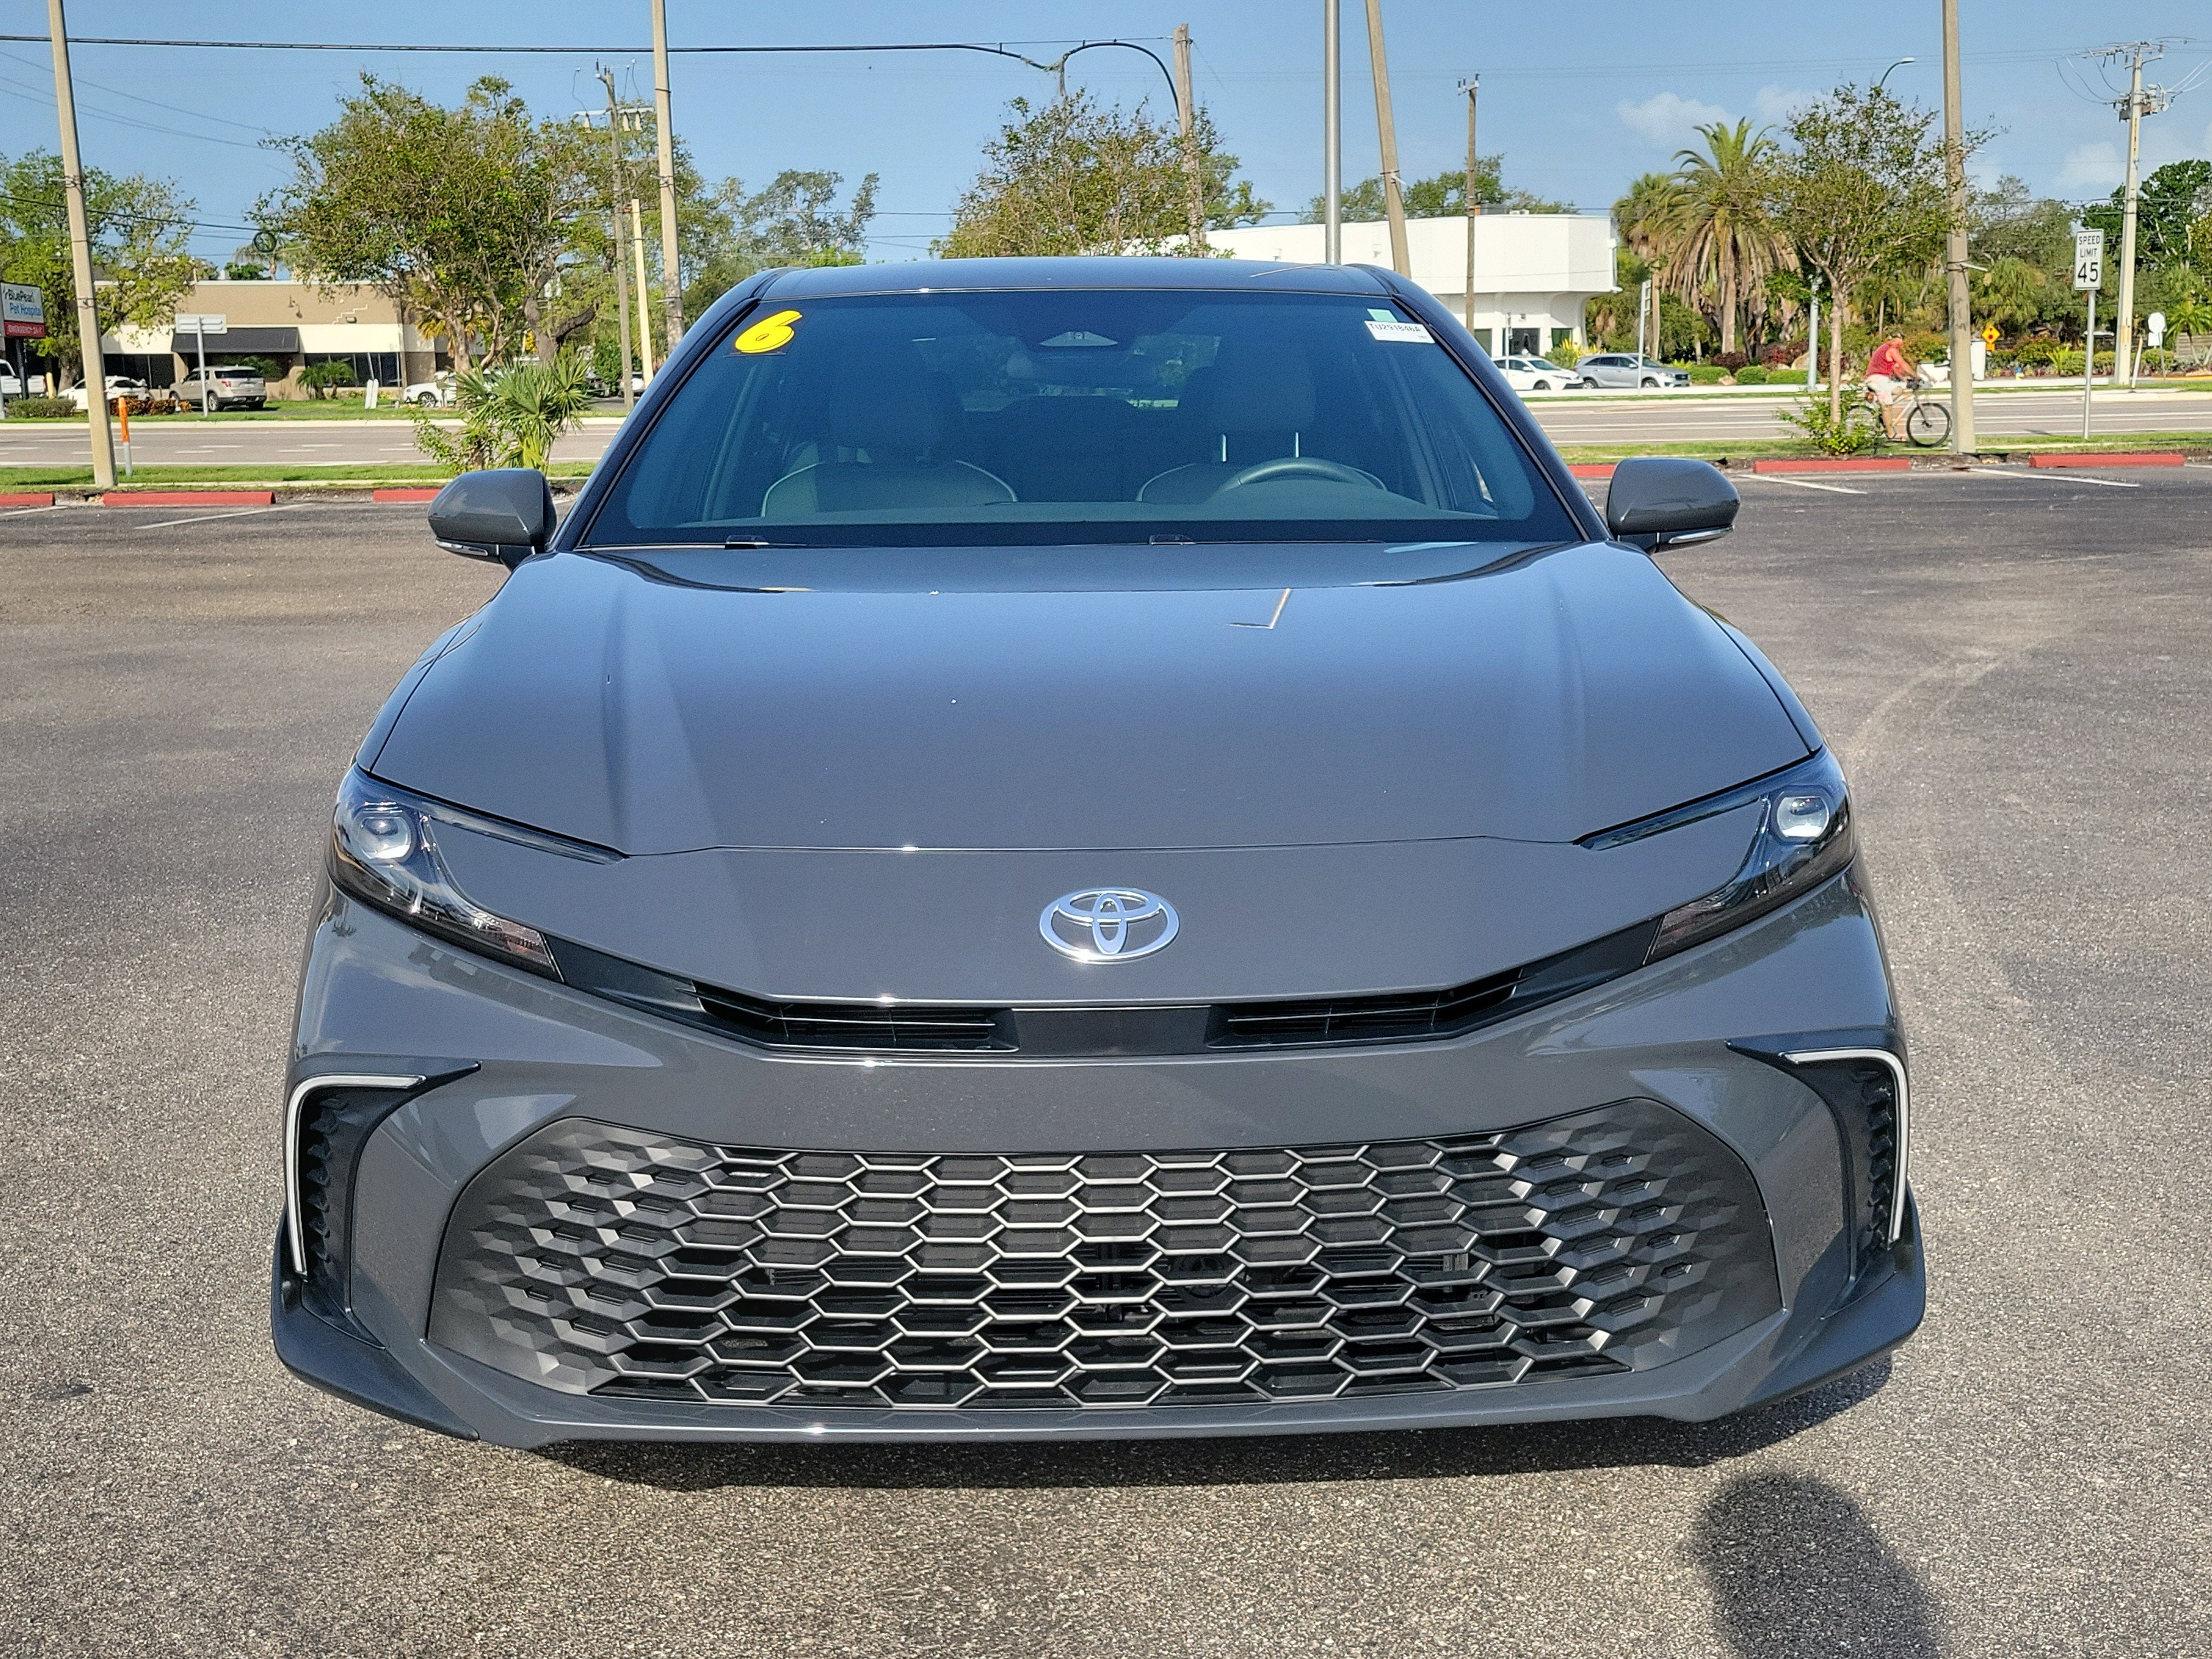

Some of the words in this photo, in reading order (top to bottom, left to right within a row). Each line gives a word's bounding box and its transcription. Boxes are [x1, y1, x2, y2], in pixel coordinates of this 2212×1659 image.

[2079, 235, 2100, 245] SPEED
[2080, 248, 2097, 258] LIMIT
[2078, 262, 2098, 283] 45
[9, 302, 19, 314] Pet
[734, 309, 803, 354] 6
